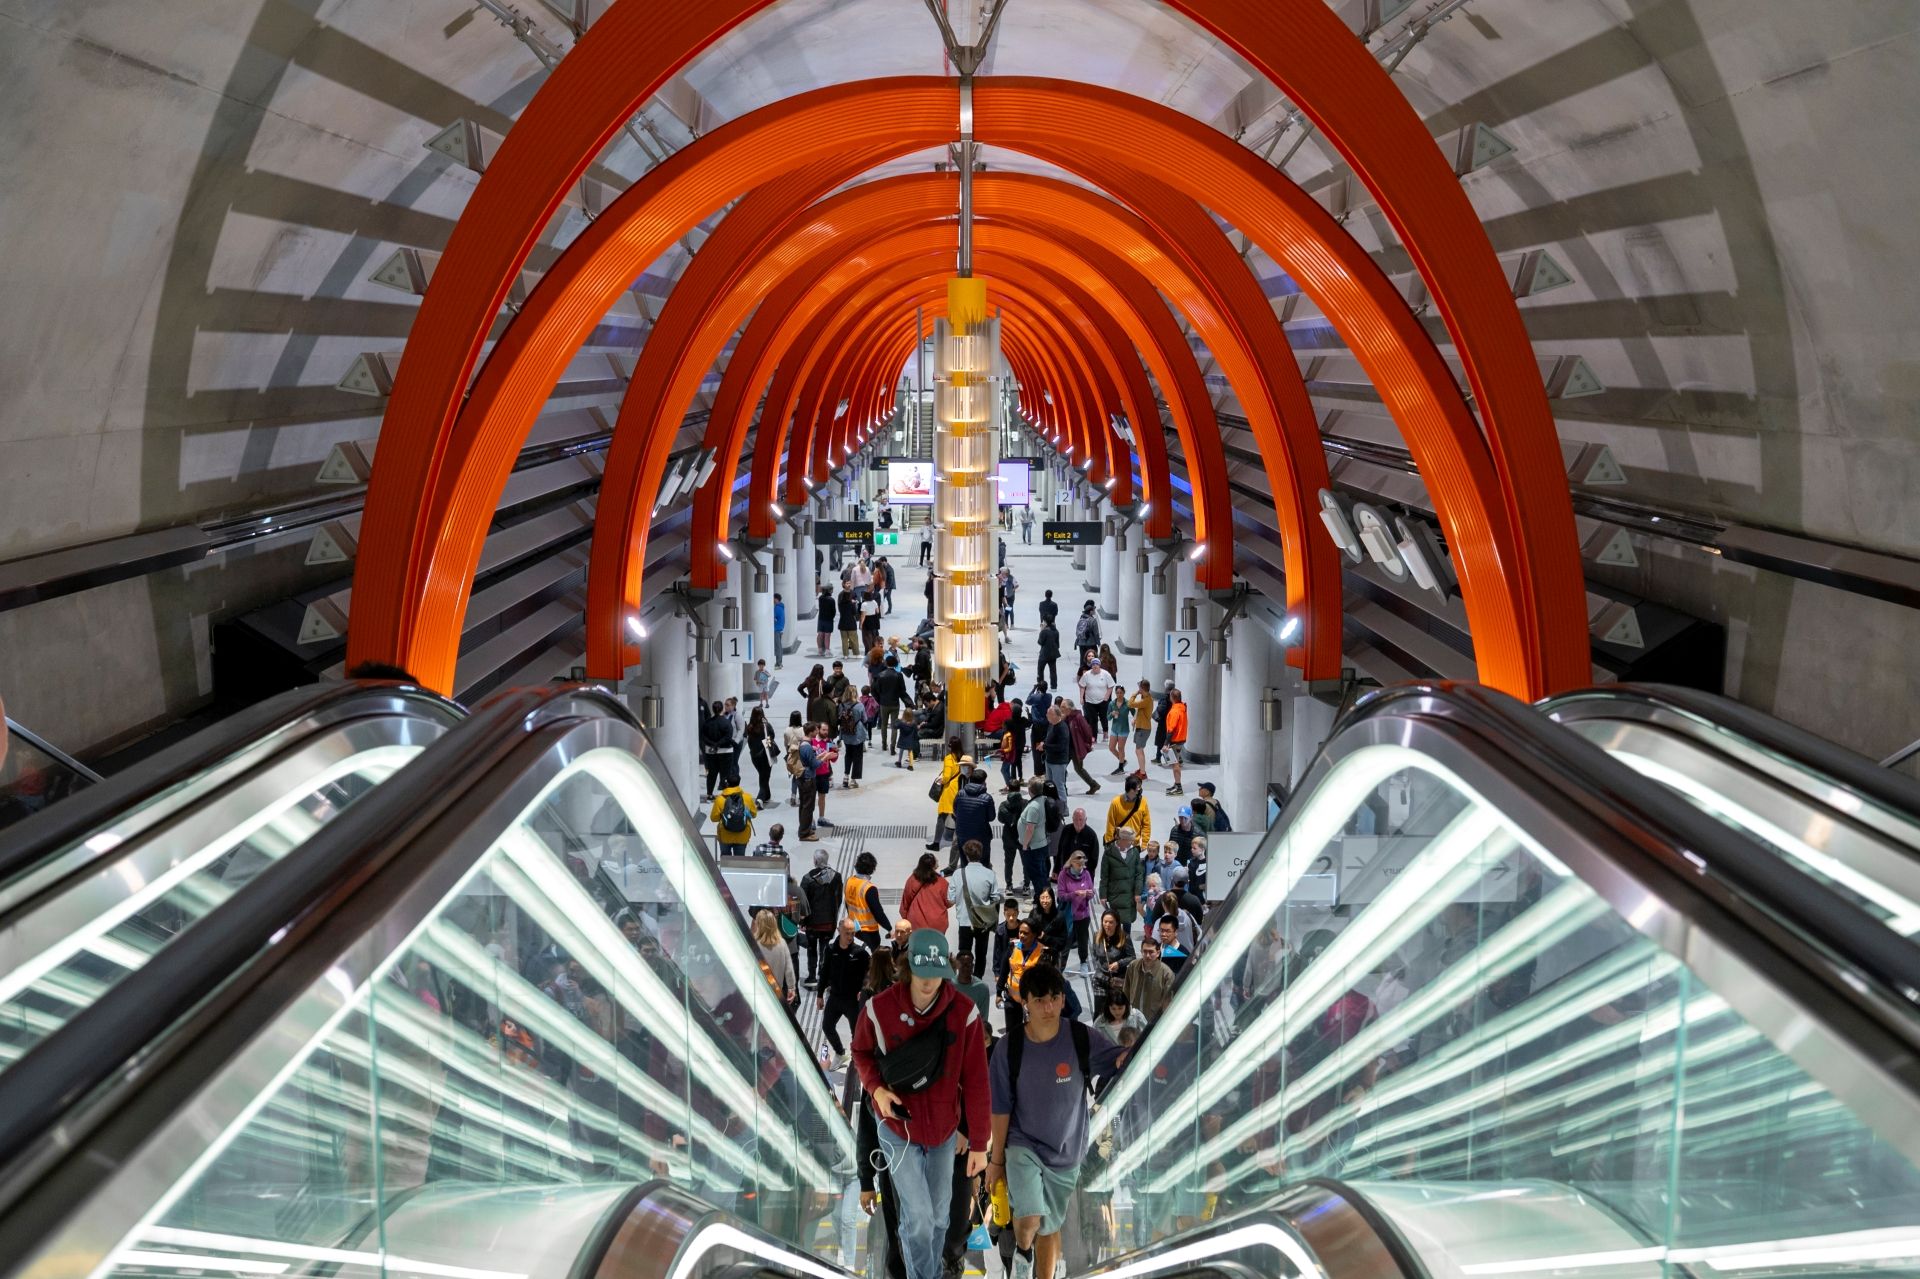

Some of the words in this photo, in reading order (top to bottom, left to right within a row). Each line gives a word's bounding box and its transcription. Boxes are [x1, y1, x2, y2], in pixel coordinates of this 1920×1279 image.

[1062, 492, 1070, 502] 2
[845, 531, 858, 539] Exit
[730, 637, 740, 657] 1
[1177, 638, 1191, 657] 2
